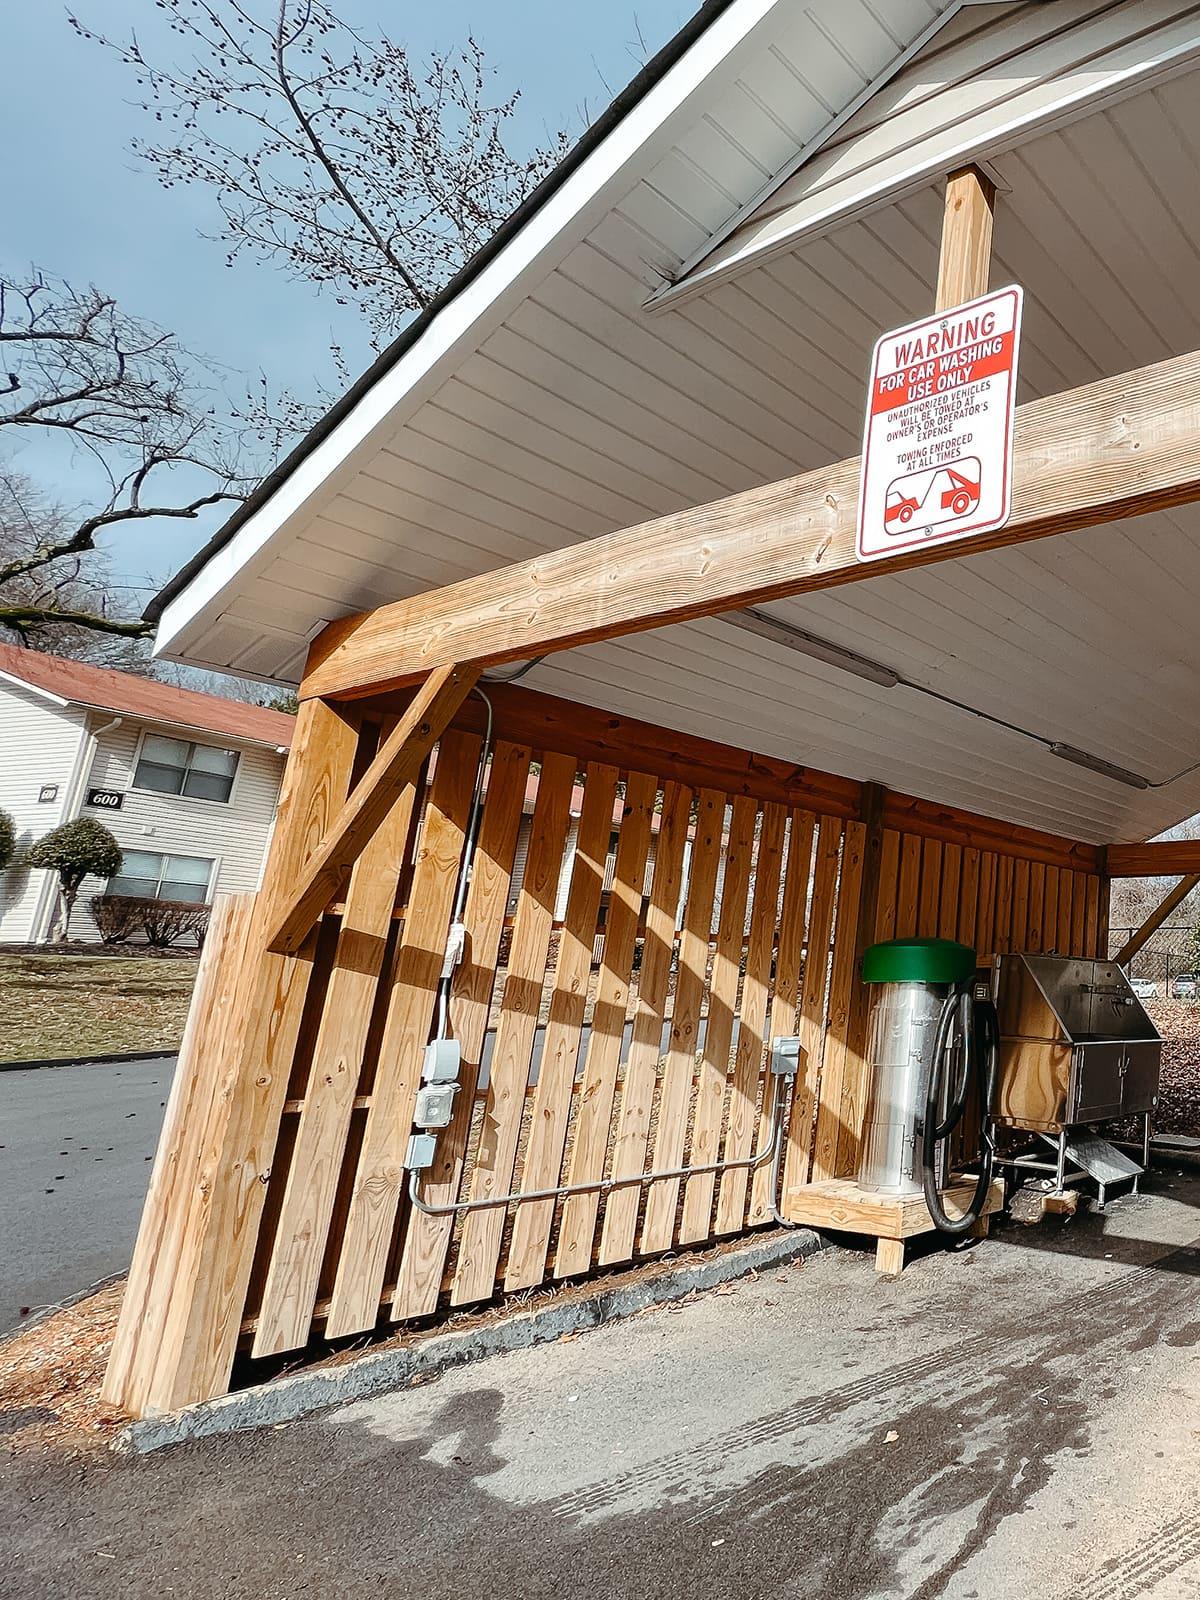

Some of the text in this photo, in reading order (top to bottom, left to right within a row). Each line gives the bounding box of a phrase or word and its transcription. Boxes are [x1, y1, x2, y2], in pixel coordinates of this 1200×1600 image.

[895, 311, 995, 368] WARNING
[879, 337, 1002, 394] FOR CAR WASHING
[908, 366, 973, 401] USE ONLY
[887, 380, 991, 422] UNAUTHORIZED VEHICLES
[900, 395, 975, 427] WILL BE TOWED AT
[886, 401, 989, 442] OWNER'S OR OPERATOR'S
[917, 422, 953, 442] EXPENSE
[896, 433, 973, 464] TOWING ENFORCED
[906, 447, 961, 471] AT ALL TIMES
[93, 794, 118, 805] 600
